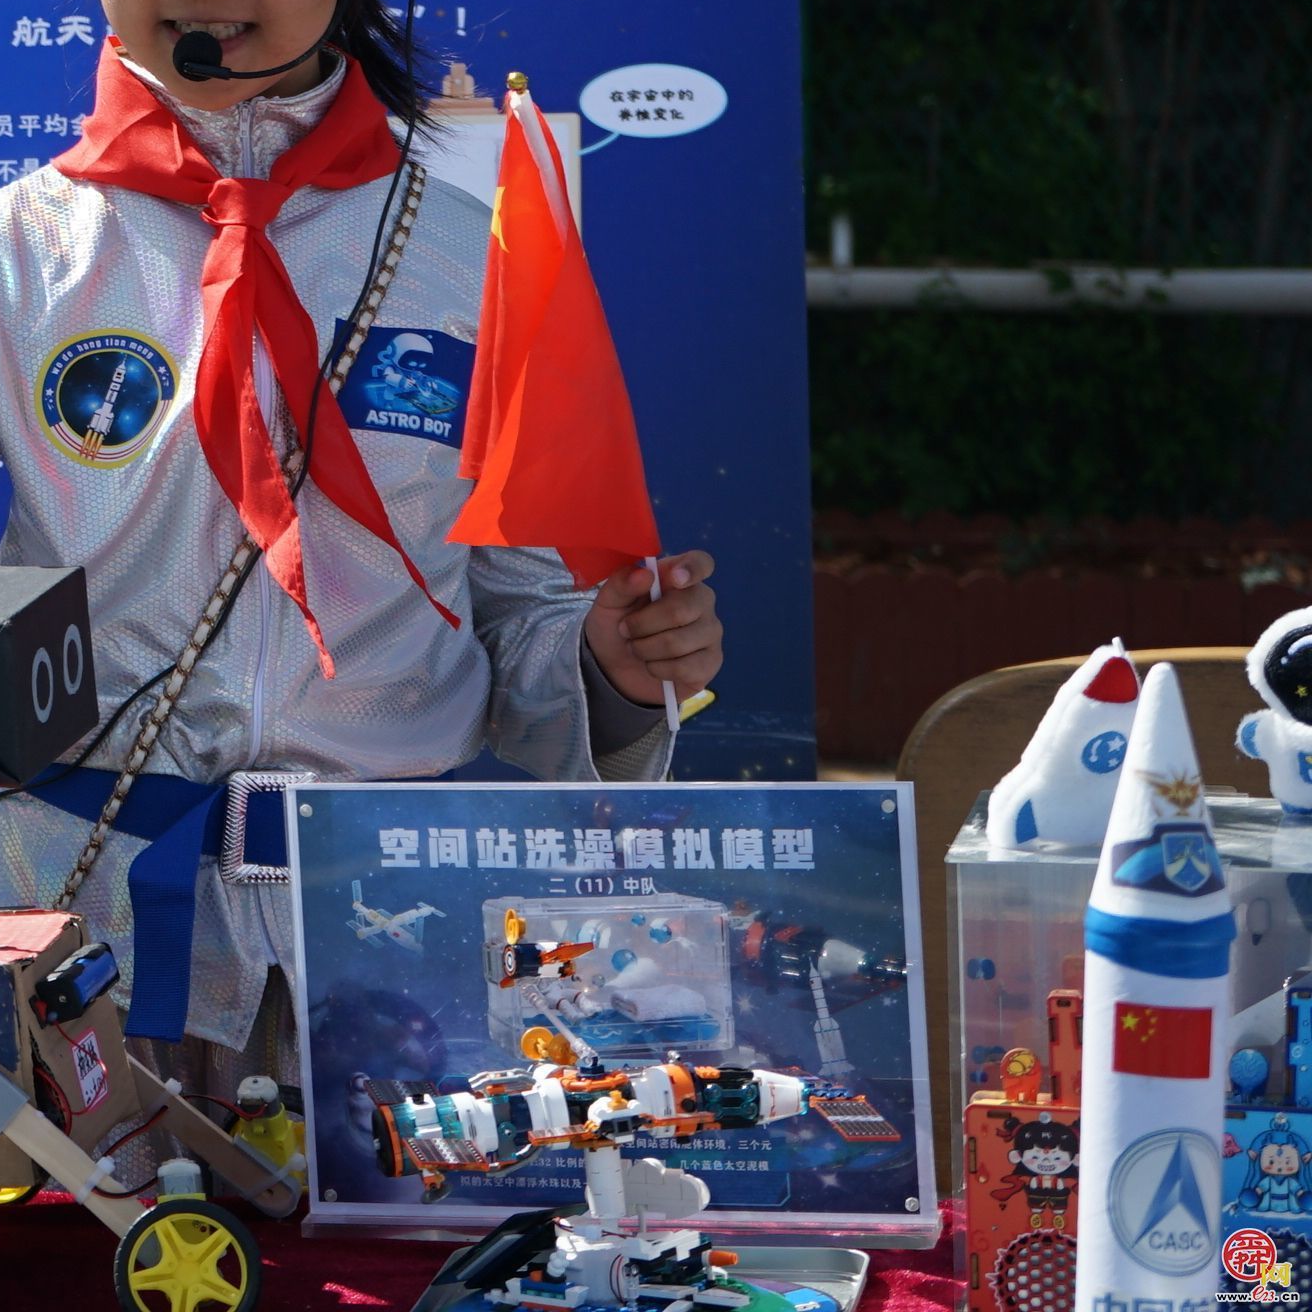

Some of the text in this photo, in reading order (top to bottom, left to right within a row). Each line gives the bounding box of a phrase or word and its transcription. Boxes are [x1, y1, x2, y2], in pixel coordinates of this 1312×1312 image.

[365, 409, 452, 438] ASTRO BOT
[378, 827, 816, 870] 空间站洗澡模拟模型
[1148, 1231, 1203, 1251] CASC
